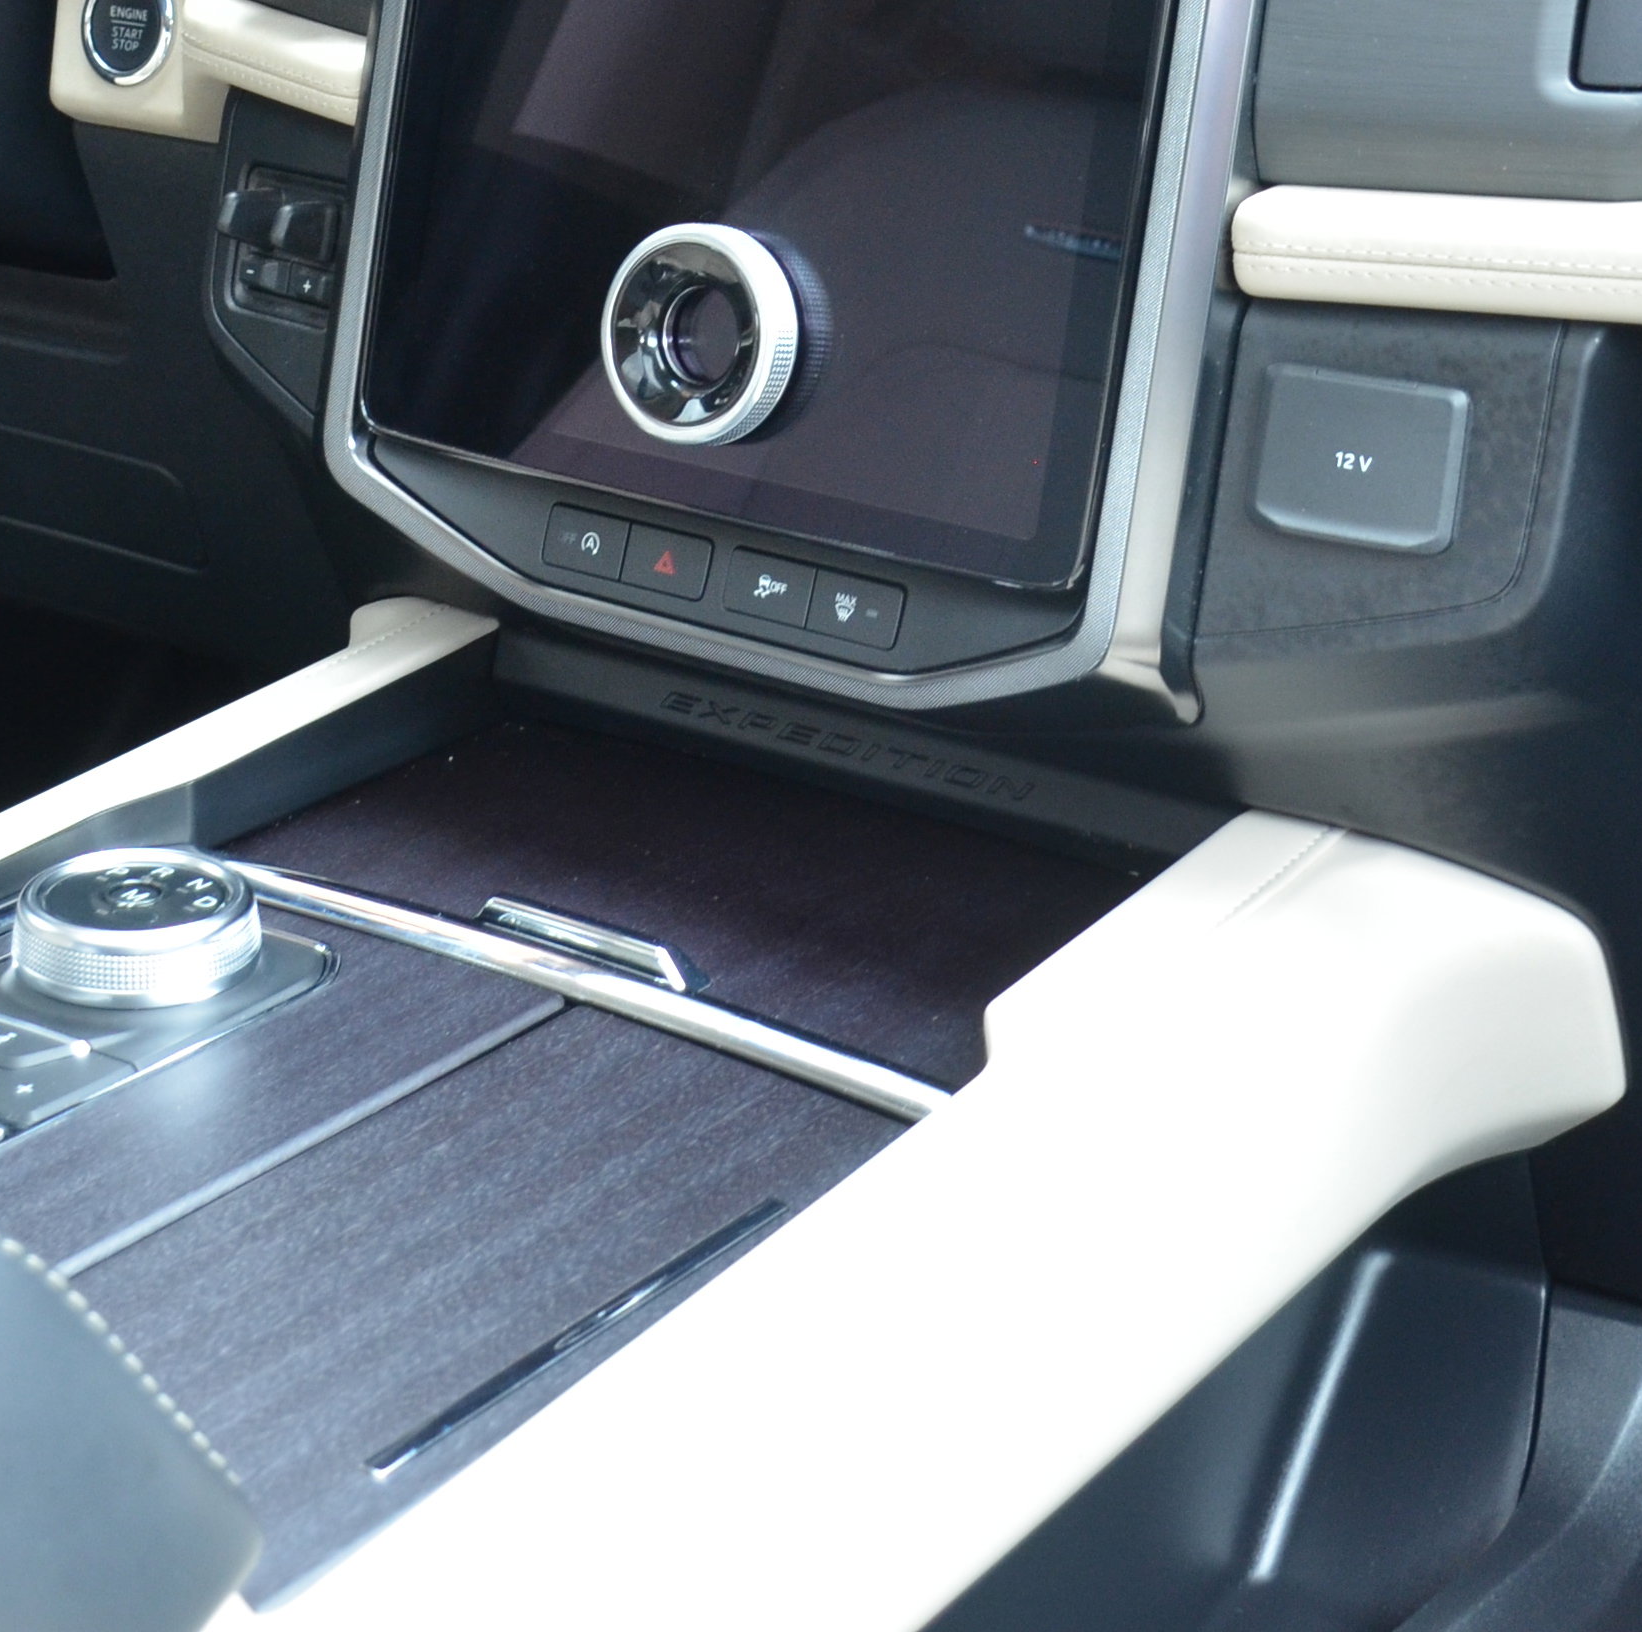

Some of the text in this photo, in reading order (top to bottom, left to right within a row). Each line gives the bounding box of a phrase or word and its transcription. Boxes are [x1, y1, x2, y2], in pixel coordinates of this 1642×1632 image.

[110, 5, 148, 22] ENGINE
[112, 26, 144, 39] START
[112, 38, 140, 51] STOP
[1335, 451, 1373, 473] 12 V
[770, 580, 789, 595] OFF
[835, 592, 859, 607] MAX
[659, 689, 1036, 801] EXPEDITION
[150, 865, 176, 879] R
[185, 877, 214, 891] N
[121, 888, 151, 902] M
[192, 895, 219, 908] D
